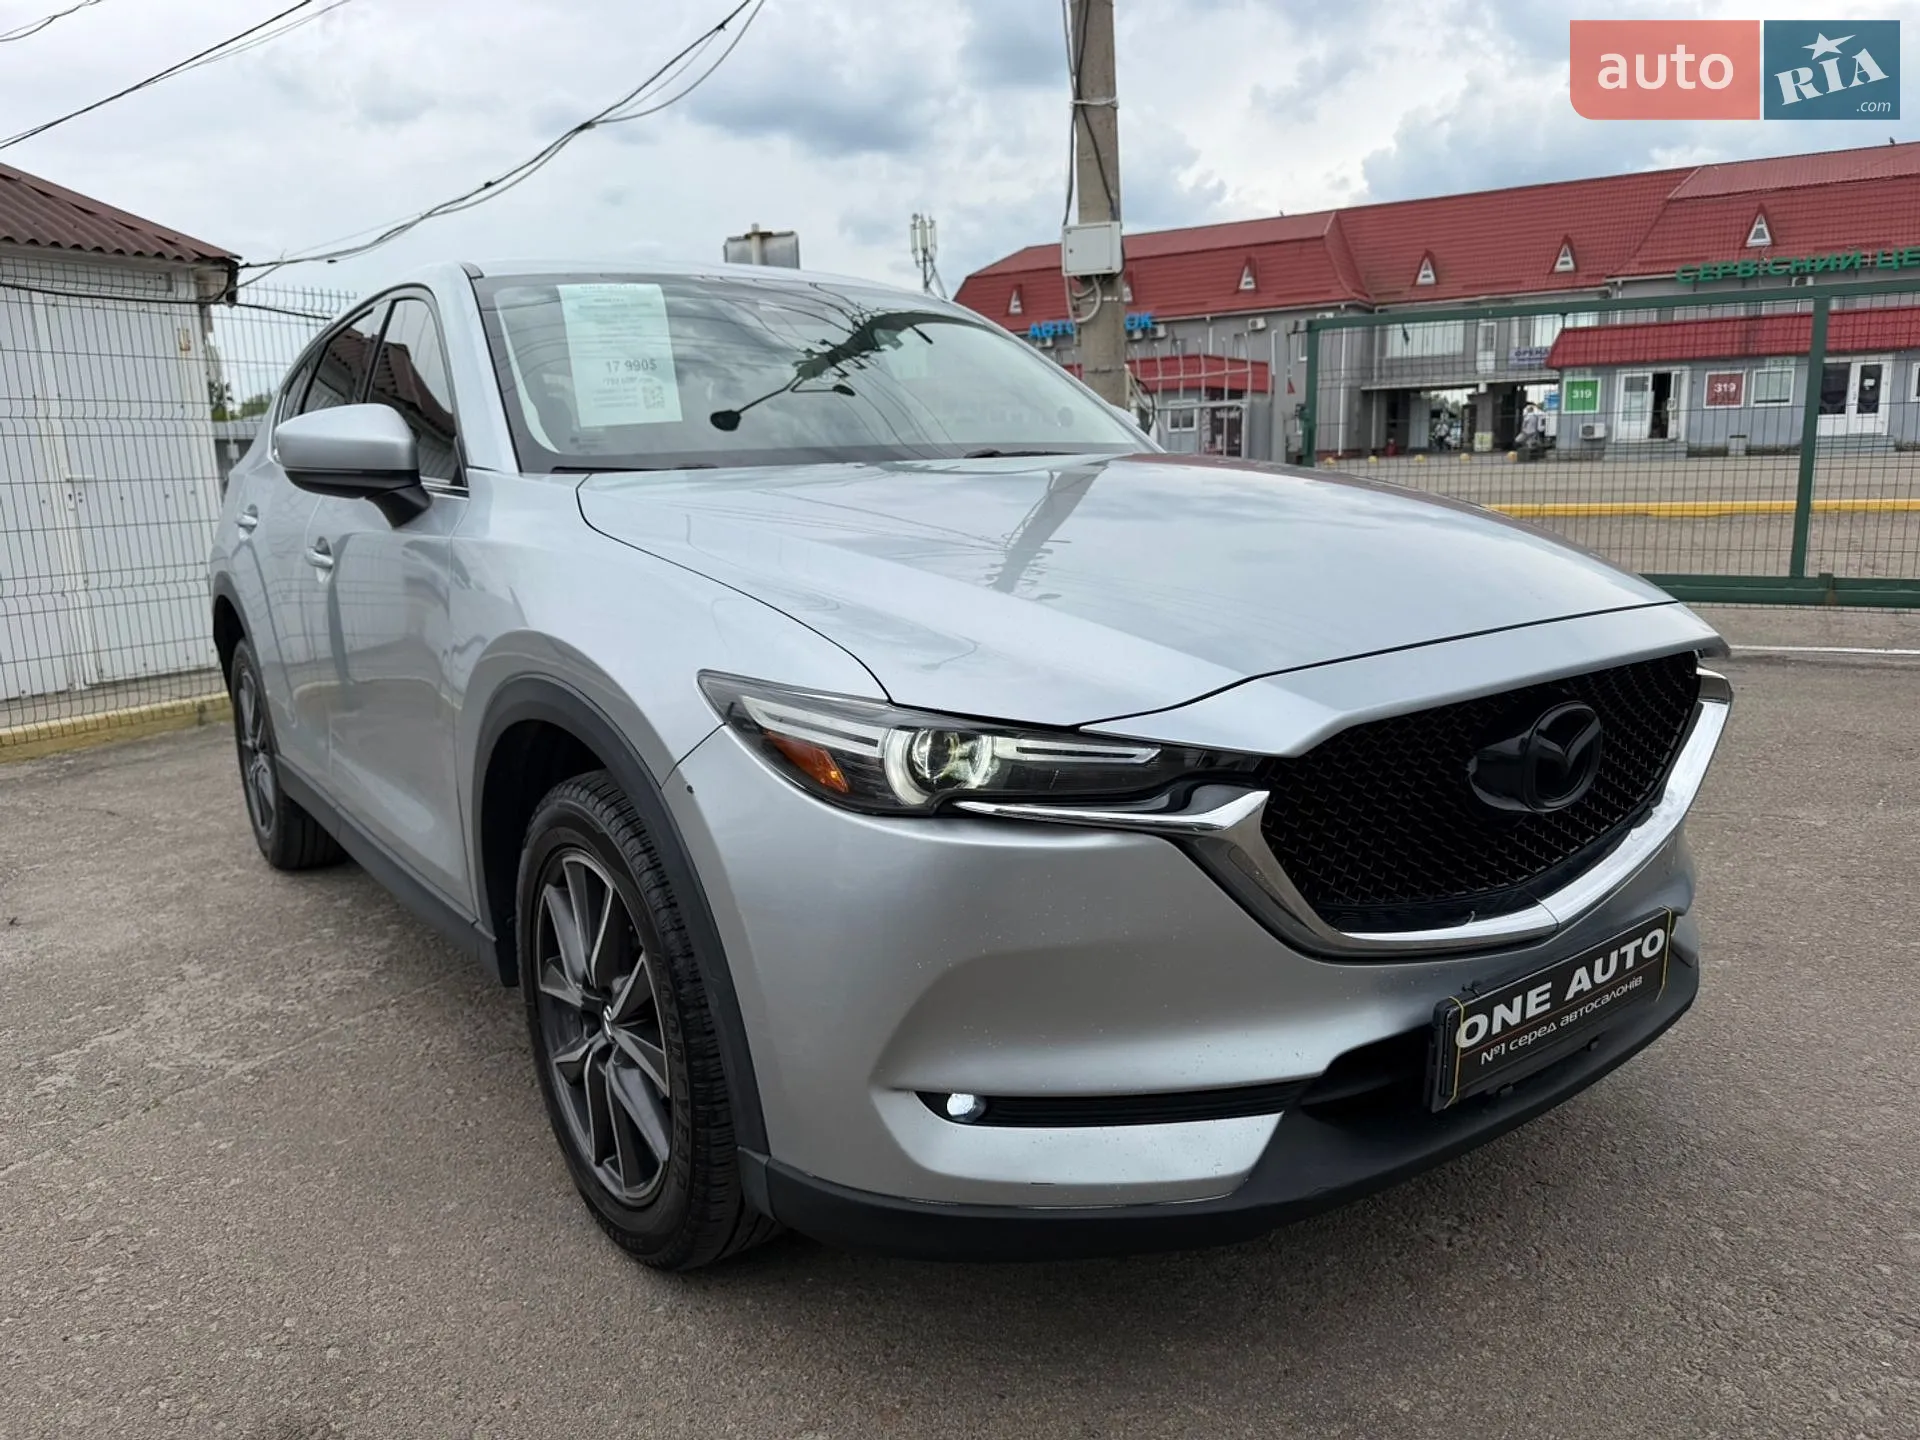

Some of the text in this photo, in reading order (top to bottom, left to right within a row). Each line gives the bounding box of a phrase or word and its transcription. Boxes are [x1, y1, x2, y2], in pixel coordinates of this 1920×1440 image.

[605, 360, 620, 373] 17
[1713, 382, 1737, 393] 319
[1455, 928, 1665, 1049] ONE AUTO
[1510, 1022, 1557, 1051] серед
[1560, 975, 1643, 1028] автосалонів
